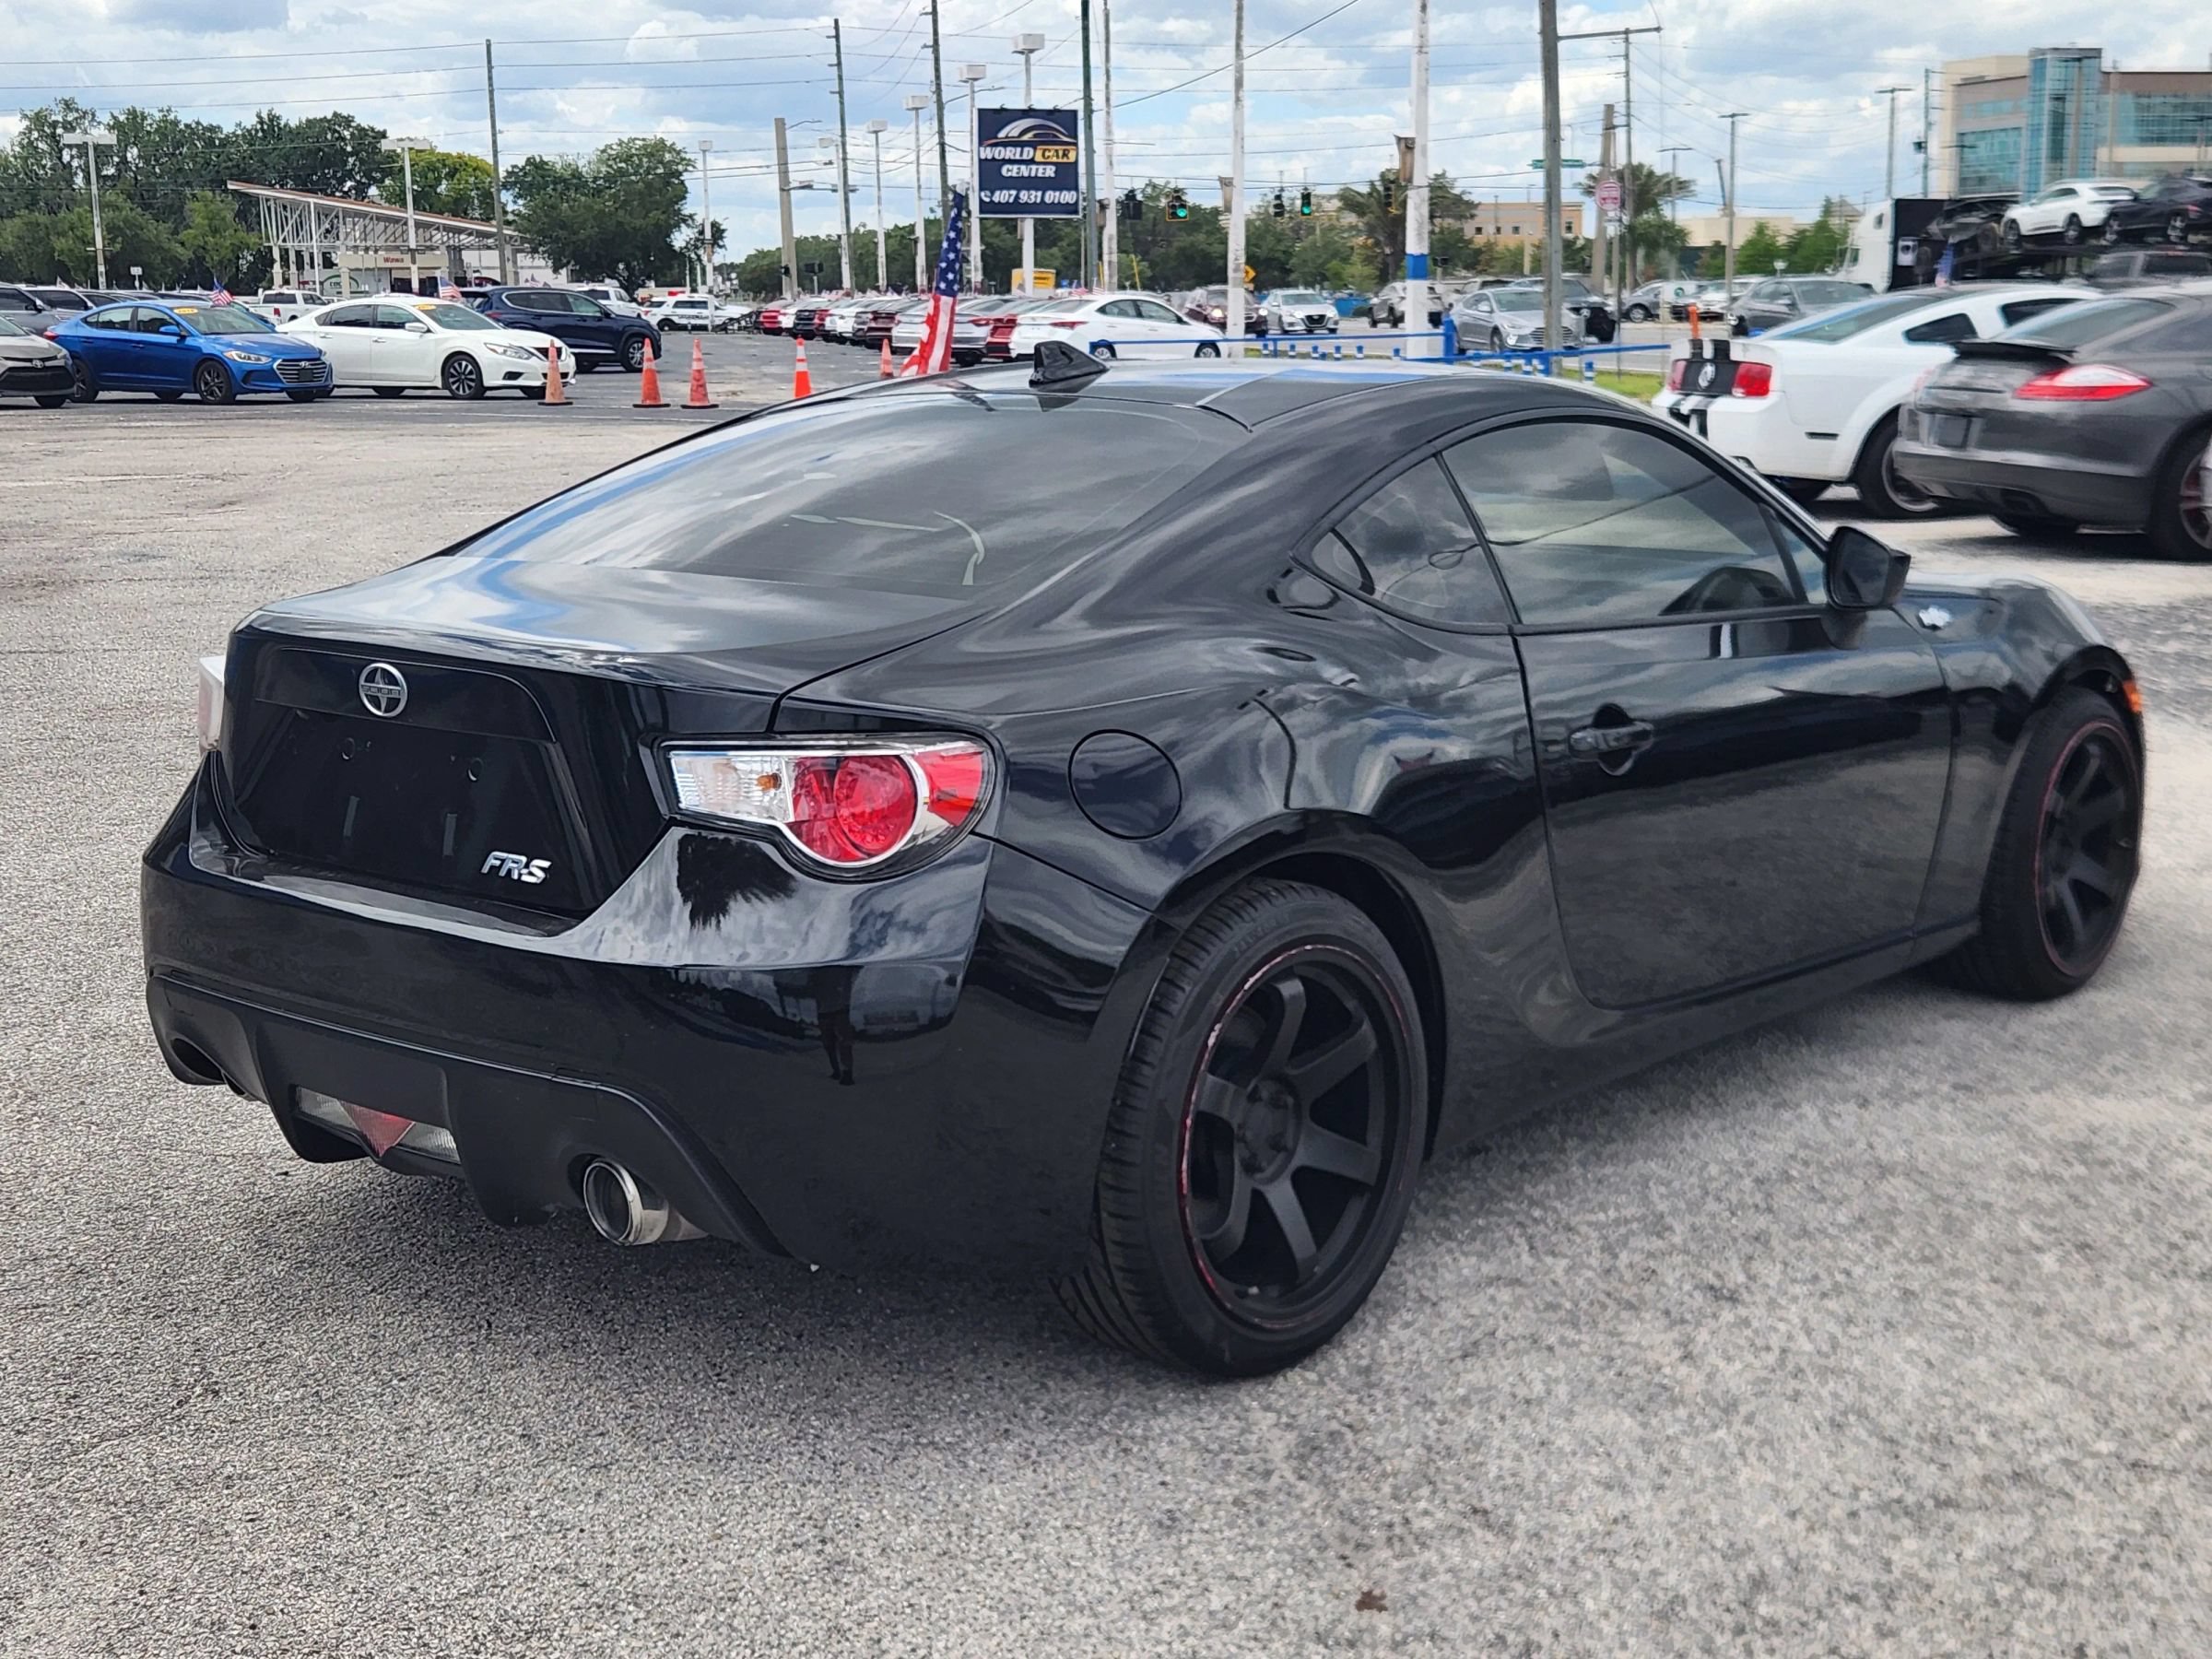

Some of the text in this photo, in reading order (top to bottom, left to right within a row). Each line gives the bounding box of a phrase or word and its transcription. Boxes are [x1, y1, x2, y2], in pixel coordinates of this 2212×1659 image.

[979, 147, 1071, 160] WORLD CAR
[1001, 164, 1056, 178] CENTER
[992, 190, 1077, 204] 407 931 0100
